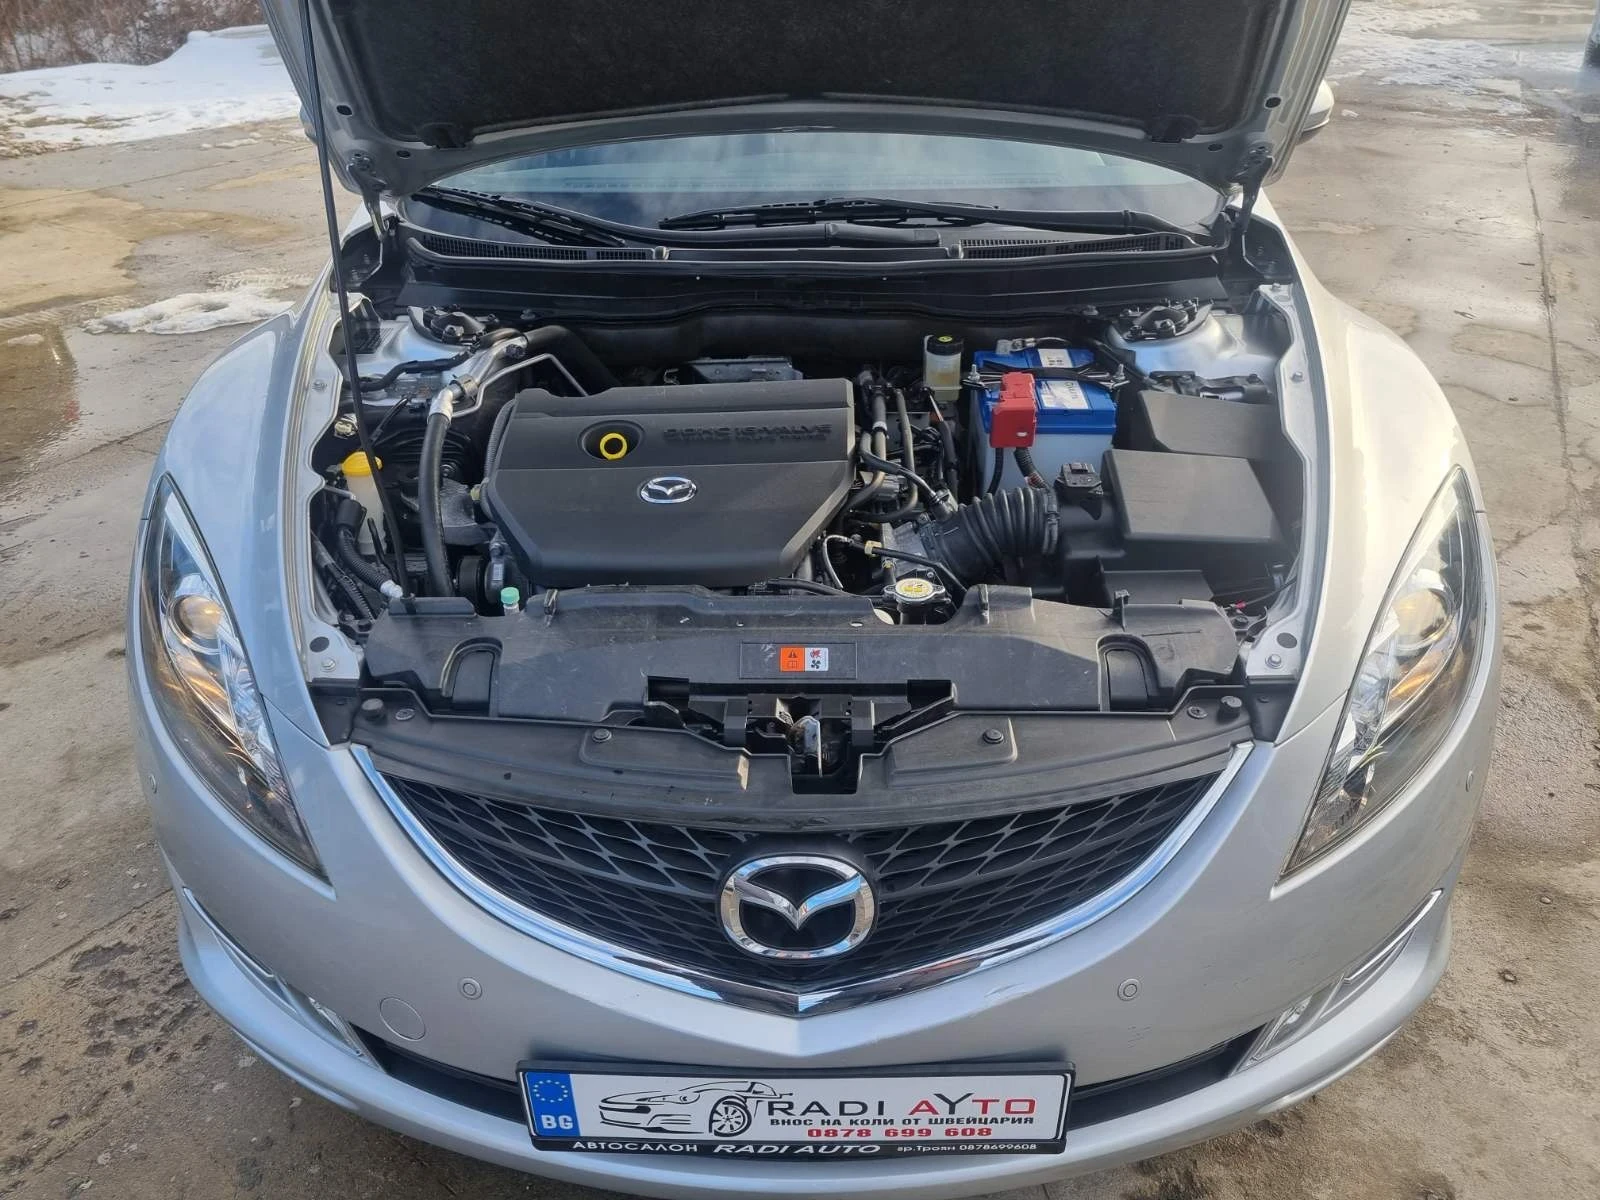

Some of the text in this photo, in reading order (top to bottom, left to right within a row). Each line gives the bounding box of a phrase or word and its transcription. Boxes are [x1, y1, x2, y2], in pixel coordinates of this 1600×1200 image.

[768, 1100, 885, 1116] RADI
[541, 1114, 574, 1130] BG
[770, 1116, 1035, 1126] ВНОС НА КОЛИ ОТ ШВЕЙЦАРИЯ
[807, 1127, 992, 1138] 0878 699 608
[572, 1141, 698, 1153] АВТОСАЛОН
[712, 1143, 881, 1154] RADI AUTO
[959, 1142, 1038, 1152] 0878699608
